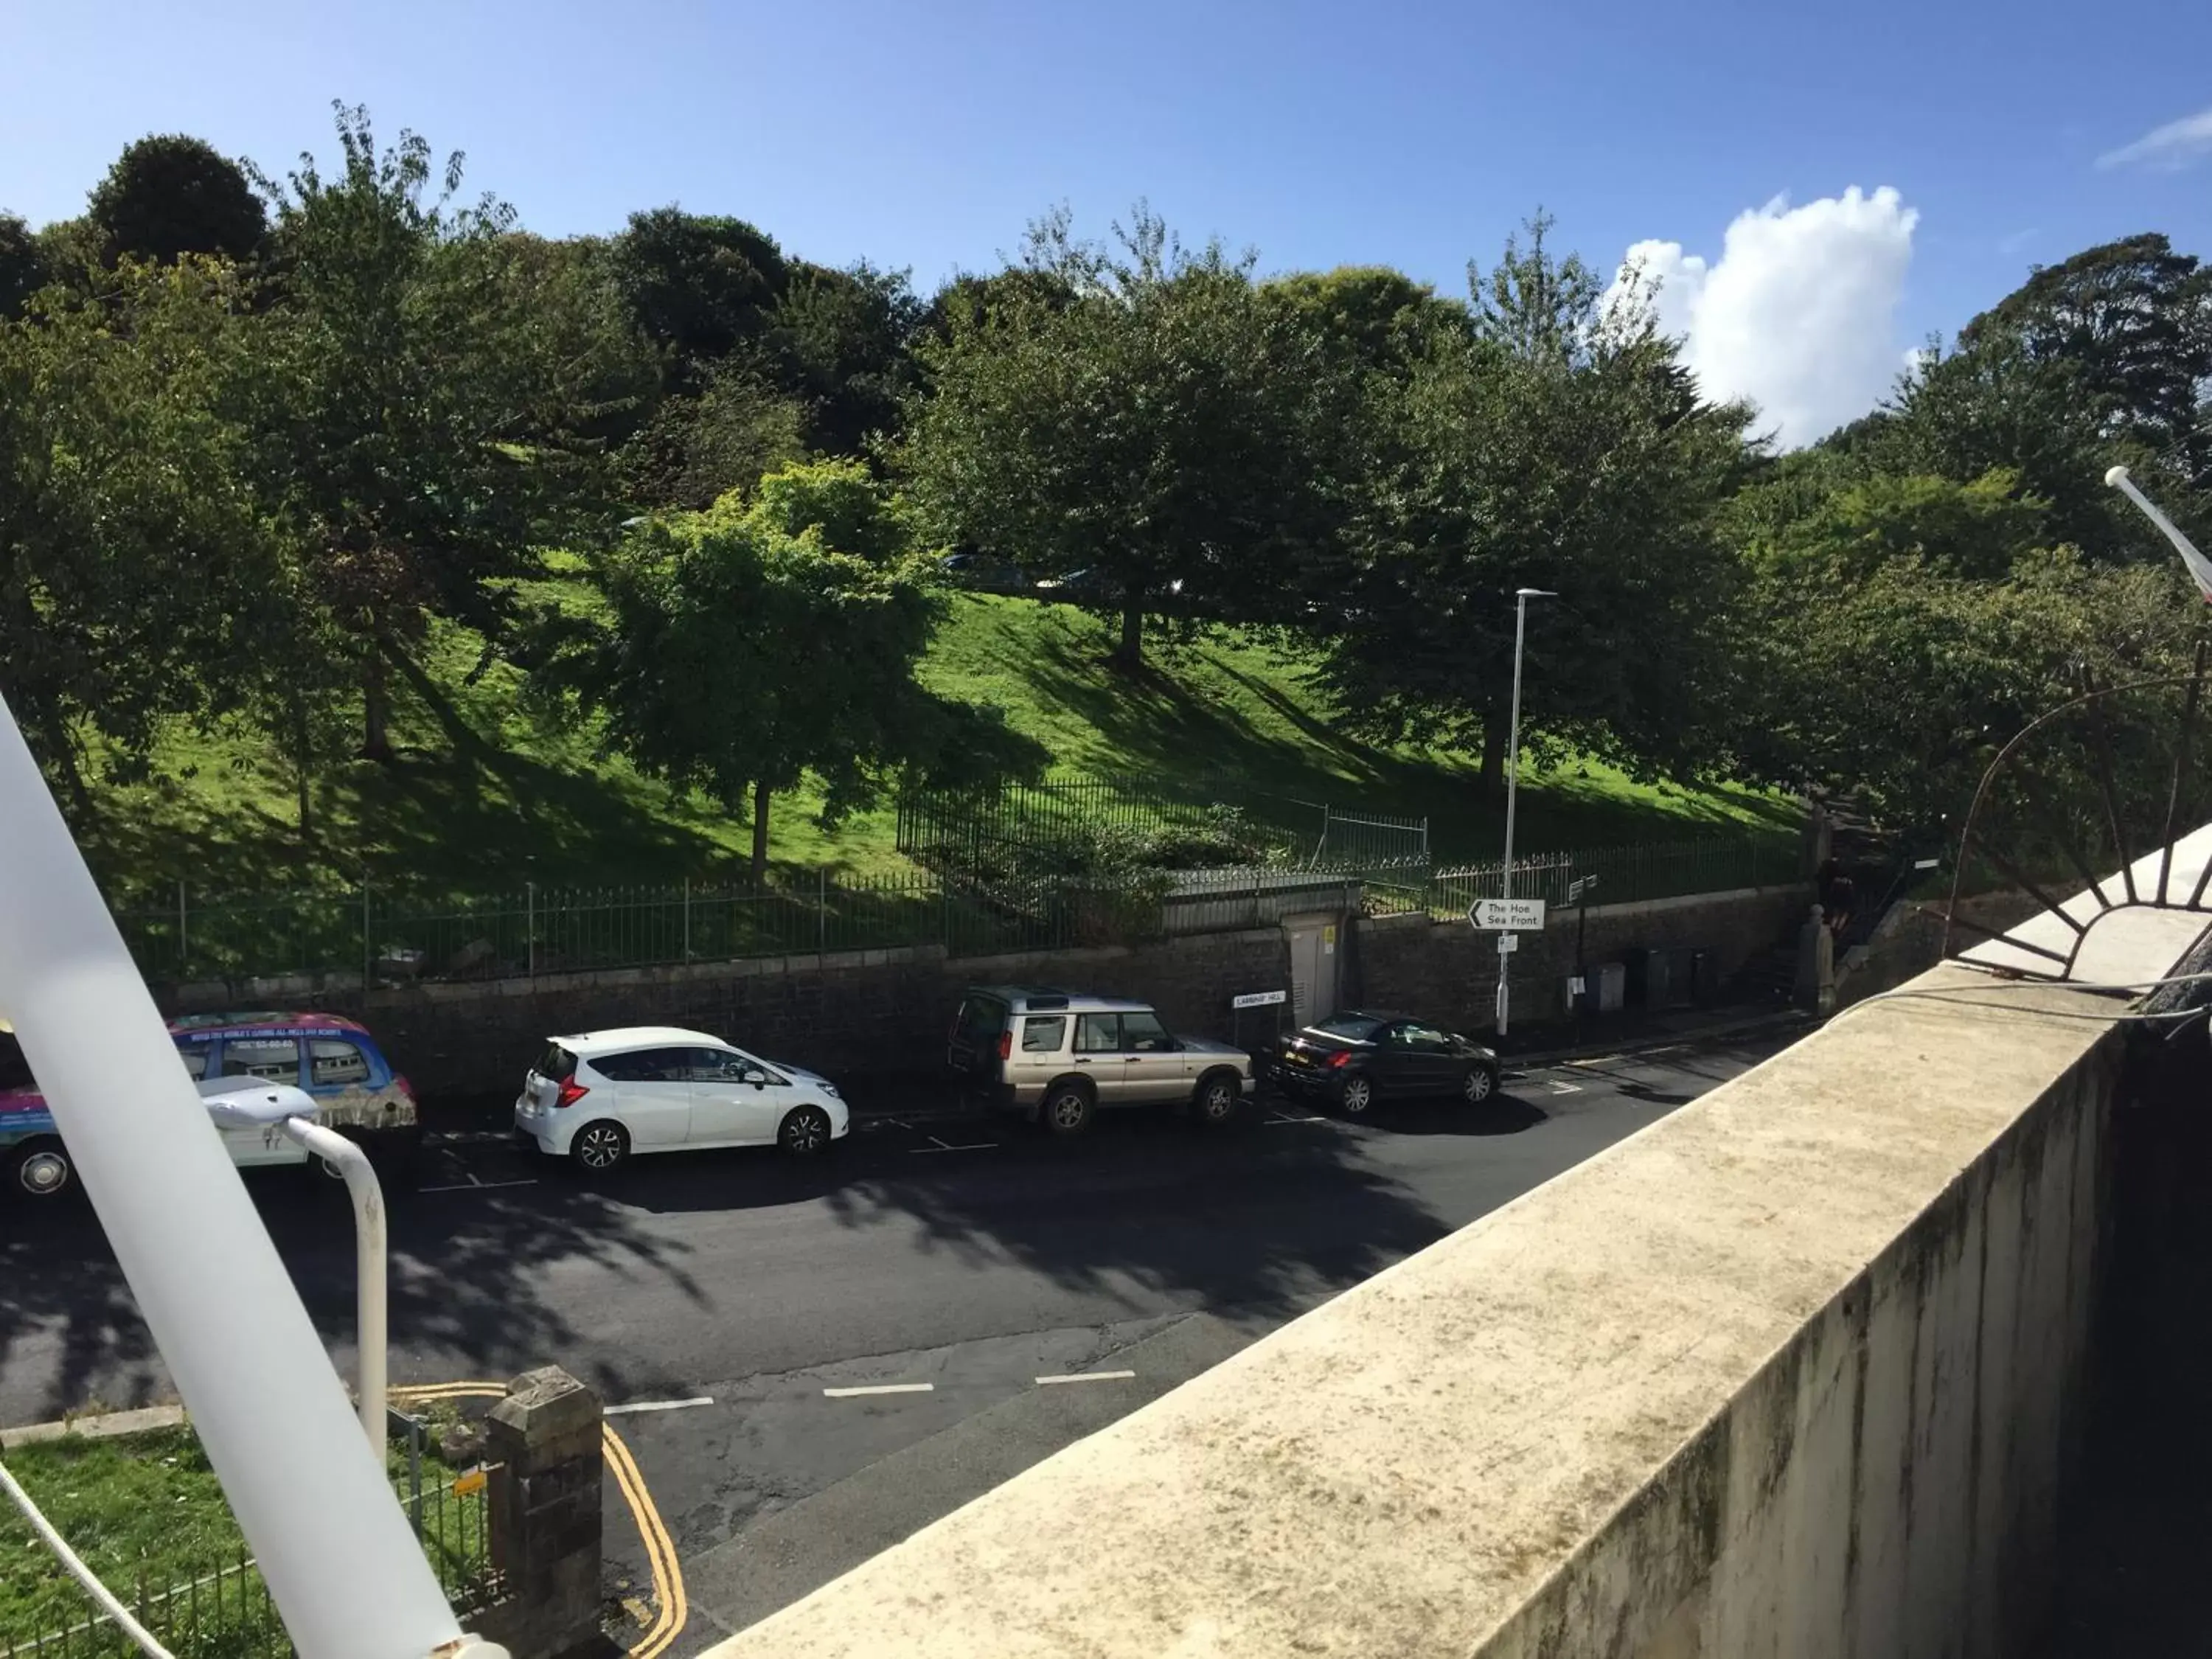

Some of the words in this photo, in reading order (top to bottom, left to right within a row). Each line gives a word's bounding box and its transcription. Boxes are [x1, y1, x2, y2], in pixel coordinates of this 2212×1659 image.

[1489, 903, 1506, 913] The
[1511, 903, 1530, 914] Hoe
[1487, 915, 1506, 924] Sea
[1512, 915, 1537, 925] Front
